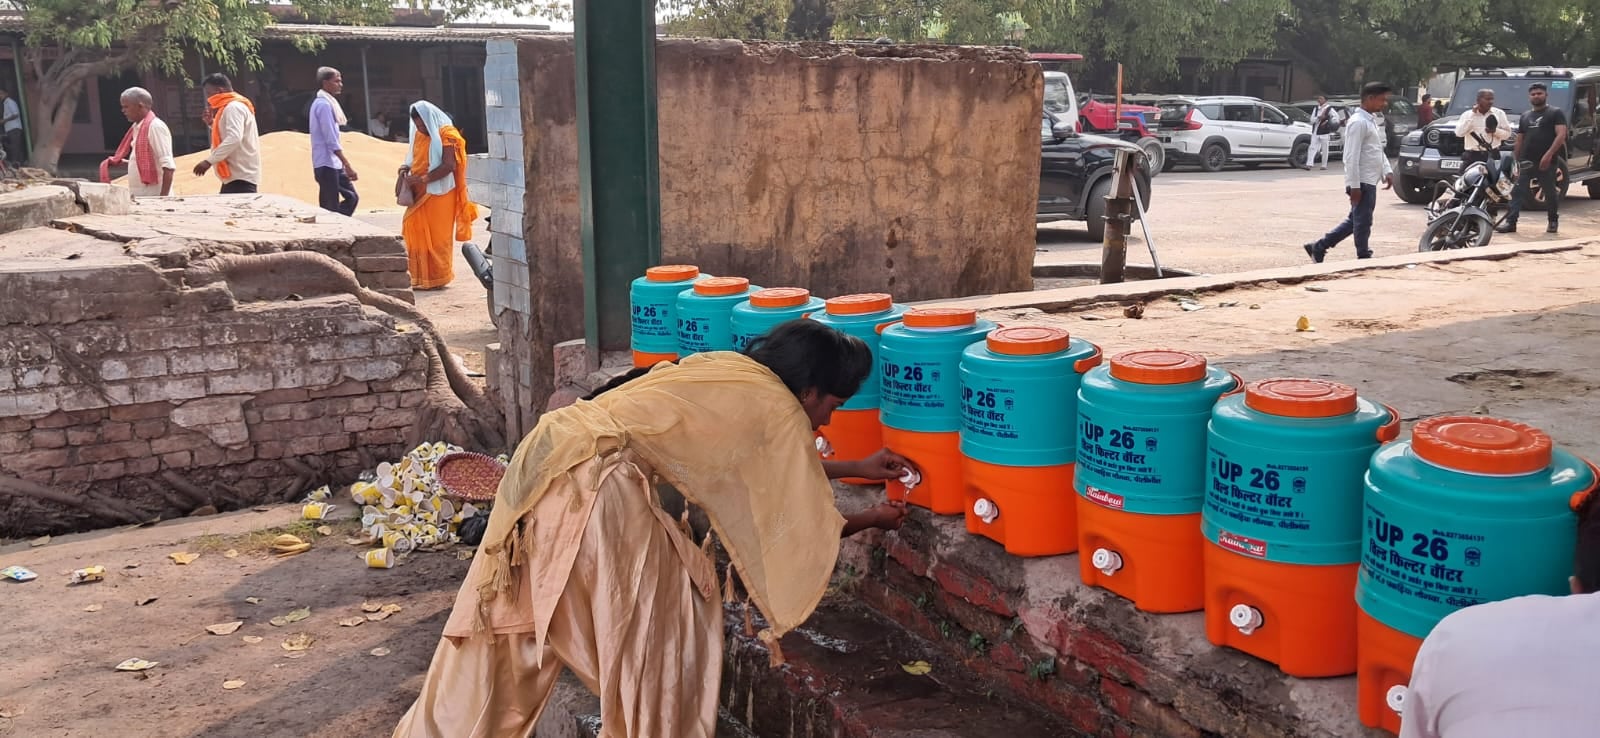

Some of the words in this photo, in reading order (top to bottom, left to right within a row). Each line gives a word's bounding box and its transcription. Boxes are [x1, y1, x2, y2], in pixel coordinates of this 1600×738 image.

[644, 306, 656, 317] 26
[686, 320, 698, 332] 26
[884, 362, 900, 378] UP
[904, 366, 924, 381] 26
[962, 384, 973, 402] UP
[977, 390, 996, 408] 26
[1084, 420, 1104, 442] UP
[1109, 430, 1134, 450] 26
[1218, 457, 1243, 483] UP
[1249, 467, 1280, 491] 26
[1376, 518, 1404, 548] UP
[1412, 533, 1449, 561] 26
[1390, 550, 1426, 576] फिल्टर
